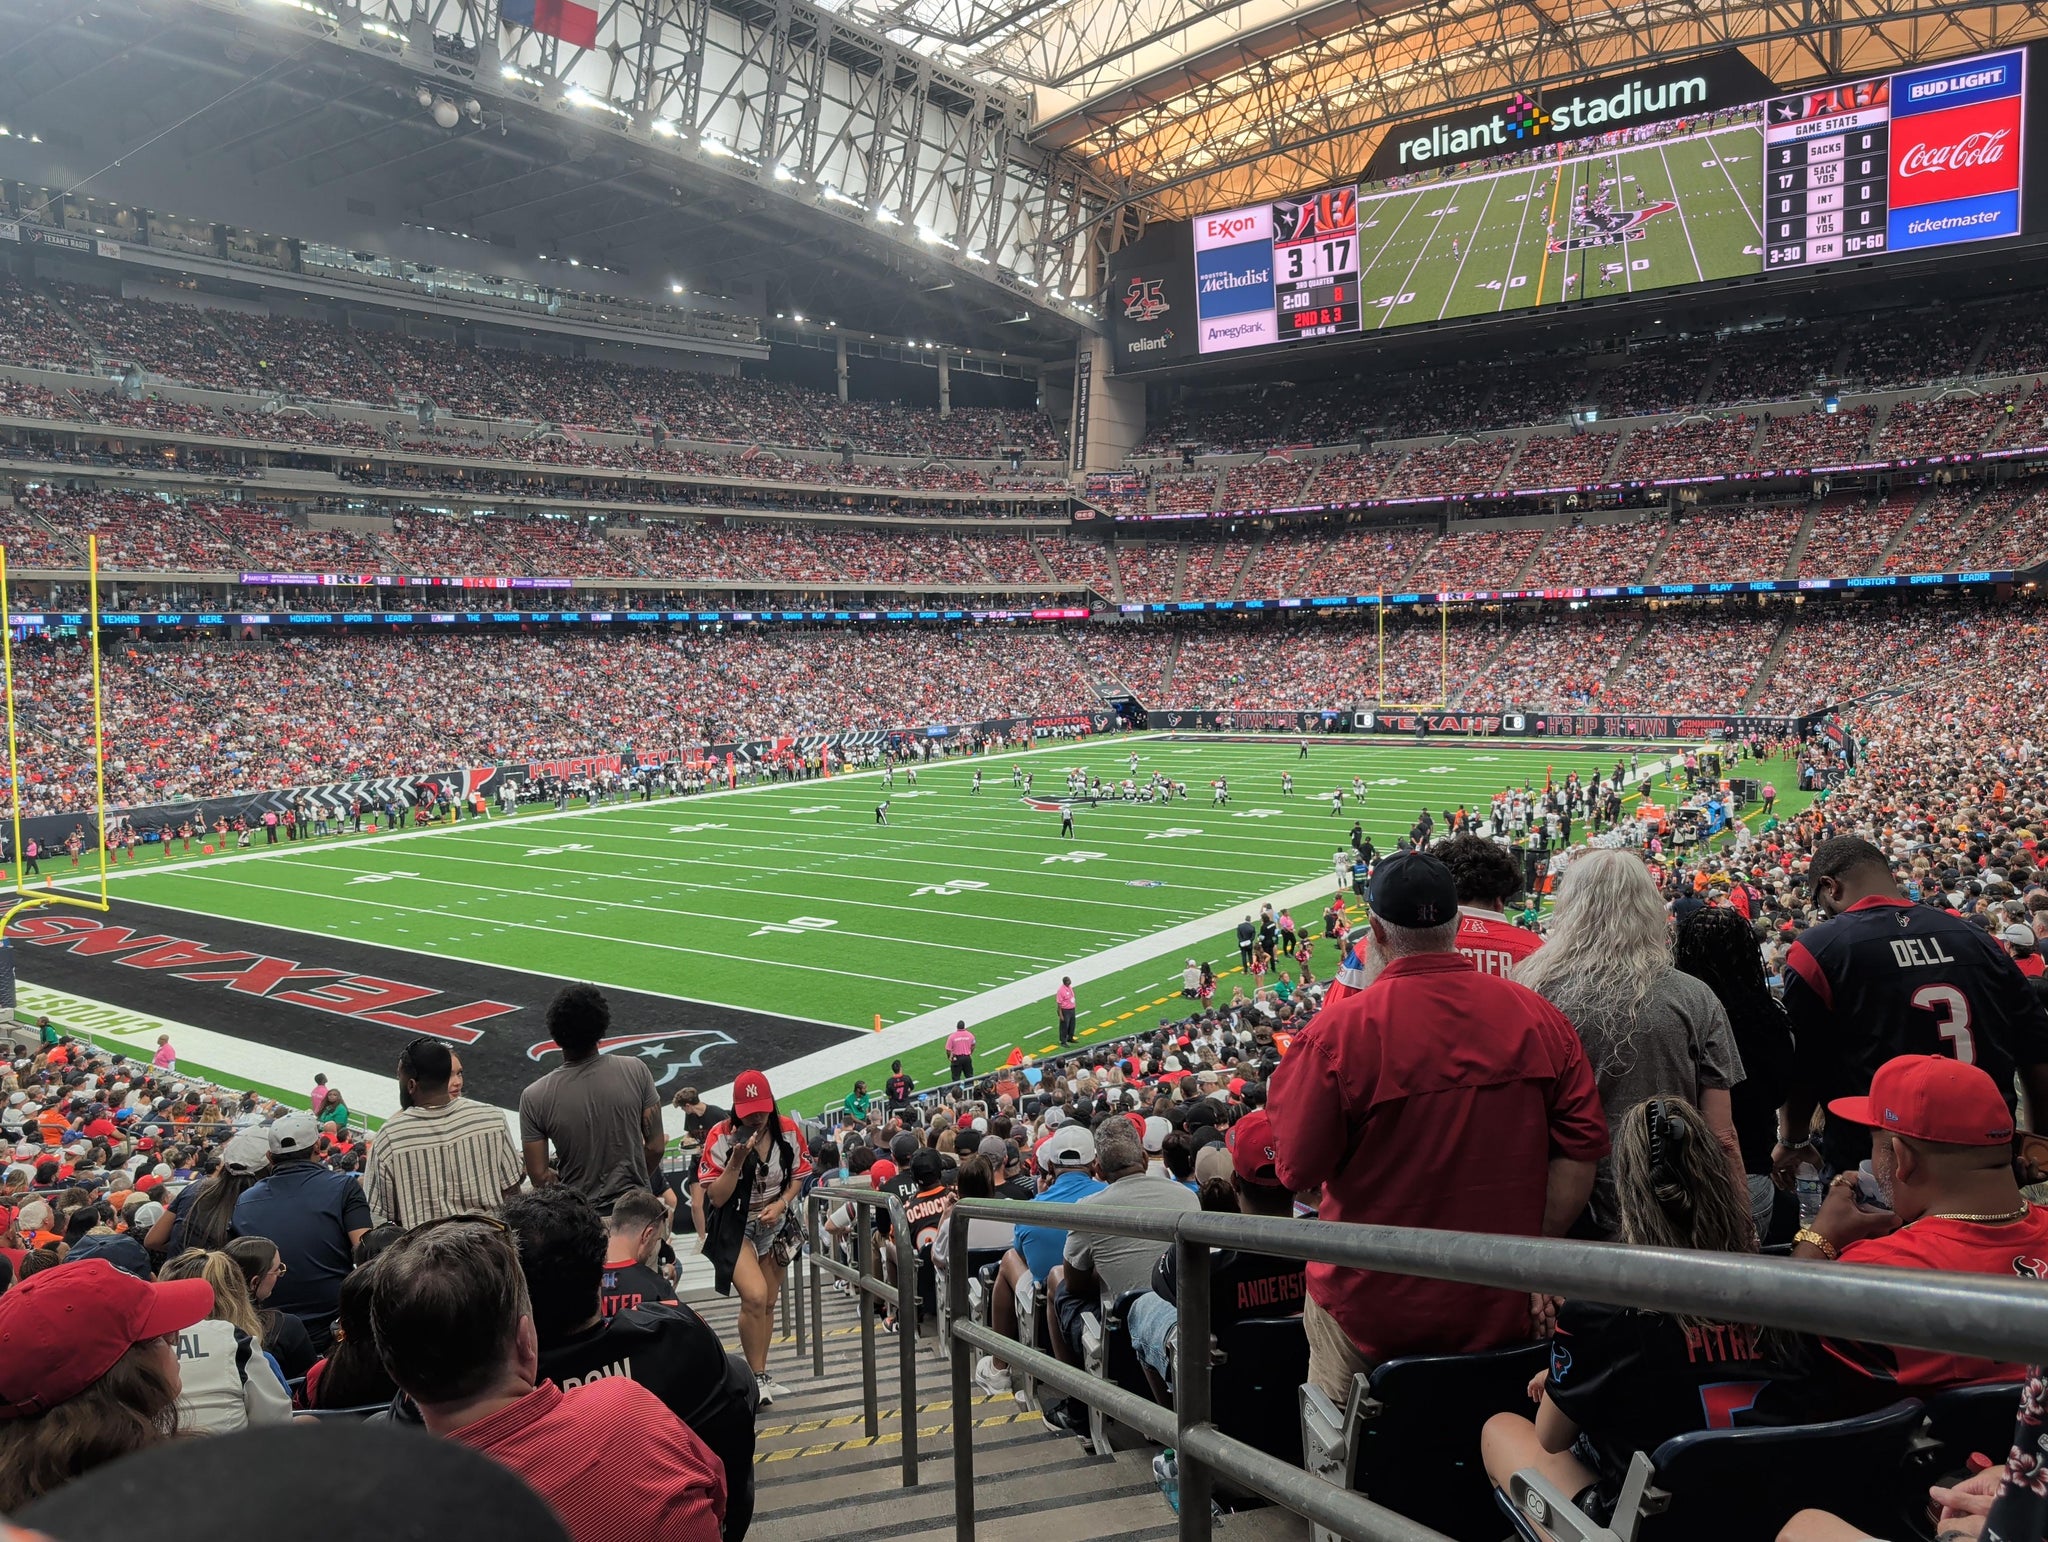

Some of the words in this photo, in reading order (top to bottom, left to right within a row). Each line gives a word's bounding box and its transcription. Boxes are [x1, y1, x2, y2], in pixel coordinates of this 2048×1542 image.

[1911, 81, 1948, 99] BUD
[1951, 69, 2001, 91] LIGHT
[1400, 115, 1507, 164] reliant
[1550, 77, 1706, 132] stadium
[1796, 123, 1823, 136] GAME
[1825, 115, 1858, 130] STATS
[1782, 150, 1791, 164] 3
[1811, 142, 1841, 156] SACKS
[1862, 135, 1871, 149] 0
[1899, 128, 2011, 178] Coca-Cola
[1813, 164, 1838, 176] SACK
[1861, 160, 1871, 174] 0
[1778, 175, 1793, 188] 17
[1816, 174, 1835, 184] YDS
[1781, 199, 1790, 213] 0
[1817, 194, 1833, 205] INT
[1861, 185, 1870, 199] 0
[1817, 214, 1833, 225] INT
[1861, 211, 1870, 225] 0
[1908, 210, 2001, 234] ticketmaster
[1207, 216, 1256, 239] Exxon
[1780, 223, 1790, 237] 0
[1816, 223, 1834, 234] YDS
[43, 234, 69, 246] TEXANS
[70, 240, 90, 250] RADIO
[1770, 247, 1800, 263] 3-30
[1815, 244, 1833, 255] PEN
[1845, 234, 1884, 252] 10-60
[1288, 247, 1304, 278] 3
[1322, 239, 1351, 272] 17
[1201, 269, 1269, 294] Methodist
[1308, 276, 1334, 288] QUARTER
[1283, 292, 1310, 310] 2:00
[1294, 310, 1318, 328] 2ND
[1321, 308, 1331, 324] &
[1333, 307, 1342, 322] 3
[1128, 336, 1167, 353] reliant
[1847, 576, 1896, 586] HOUSTON'S
[1910, 574, 1943, 584] SPORTS
[1958, 571, 1990, 582] LEADER
[1627, 586, 1643, 594] THE
[1660, 584, 1693, 593] TEXANS
[1709, 583, 1732, 592] PLAY
[1750, 581, 1776, 590] HERE.
[1312, 596, 1347, 605] HOUSTON'S
[1393, 593, 1420, 602] LEADER
[62, 615, 82, 624] THE
[102, 615, 140, 624] TEXANS
[157, 615, 181, 624] PLAY
[199, 615, 225, 624] HERE.
[290, 615, 332, 623] HOUSTON'S
[344, 614, 372, 623] SPORTS
[384, 614, 412, 623] LEADER
[466, 614, 480, 622] THE
[493, 614, 520, 622] TEXANS
[532, 613, 549, 622] PLAY
[668, 612, 689, 621] SPORTS
[698, 612, 719, 621] LEADER
[1034, 716, 1092, 727] HOUSTON
[1890, 937, 1954, 967] DELL
[2, 916, 525, 1044] TEXANS
[1911, 983, 1977, 1065] 3
